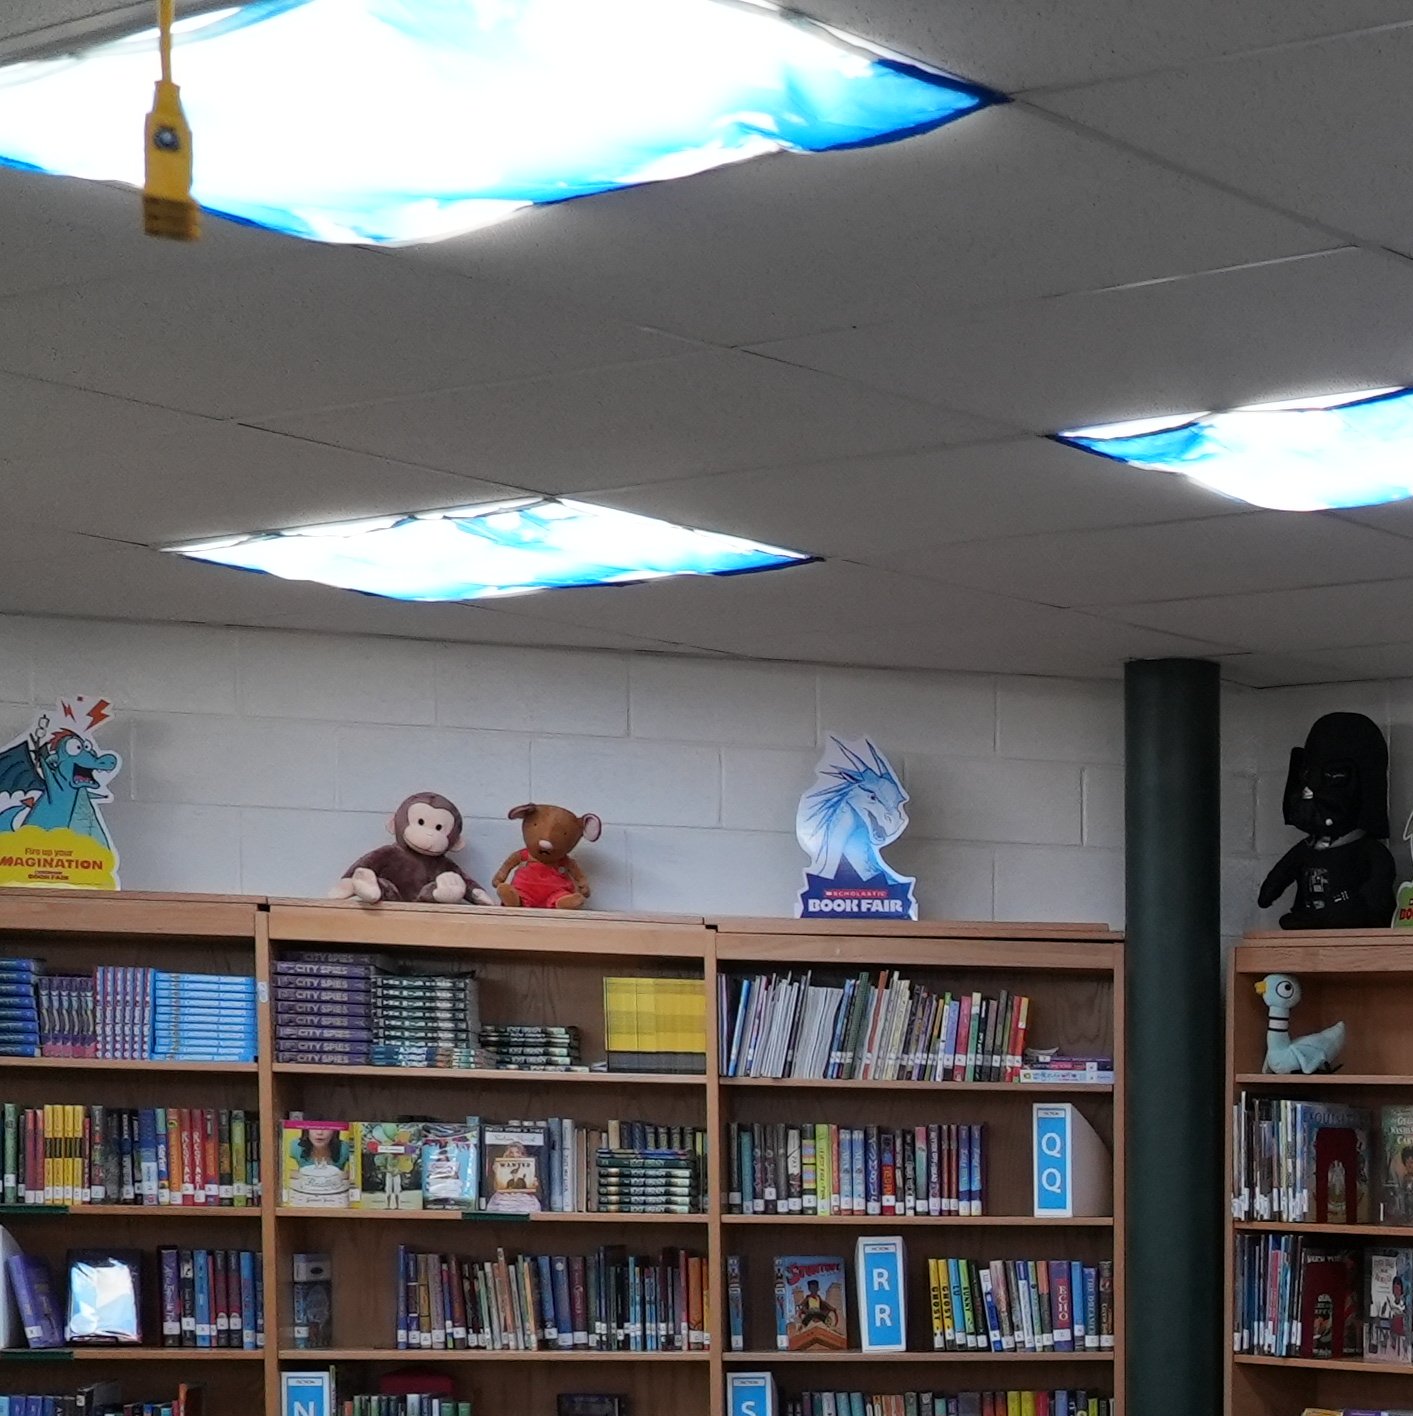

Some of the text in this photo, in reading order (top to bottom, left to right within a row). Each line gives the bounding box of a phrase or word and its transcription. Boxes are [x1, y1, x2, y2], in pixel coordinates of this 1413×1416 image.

[808, 899, 902, 912] BOOK FAIR
[1042, 1132, 1061, 1158] Q
[1042, 1168, 1061, 1193] Q
[873, 1268, 890, 1290] R
[874, 1304, 892, 1327] R
[1058, 1286, 1068, 1321] ECHO
